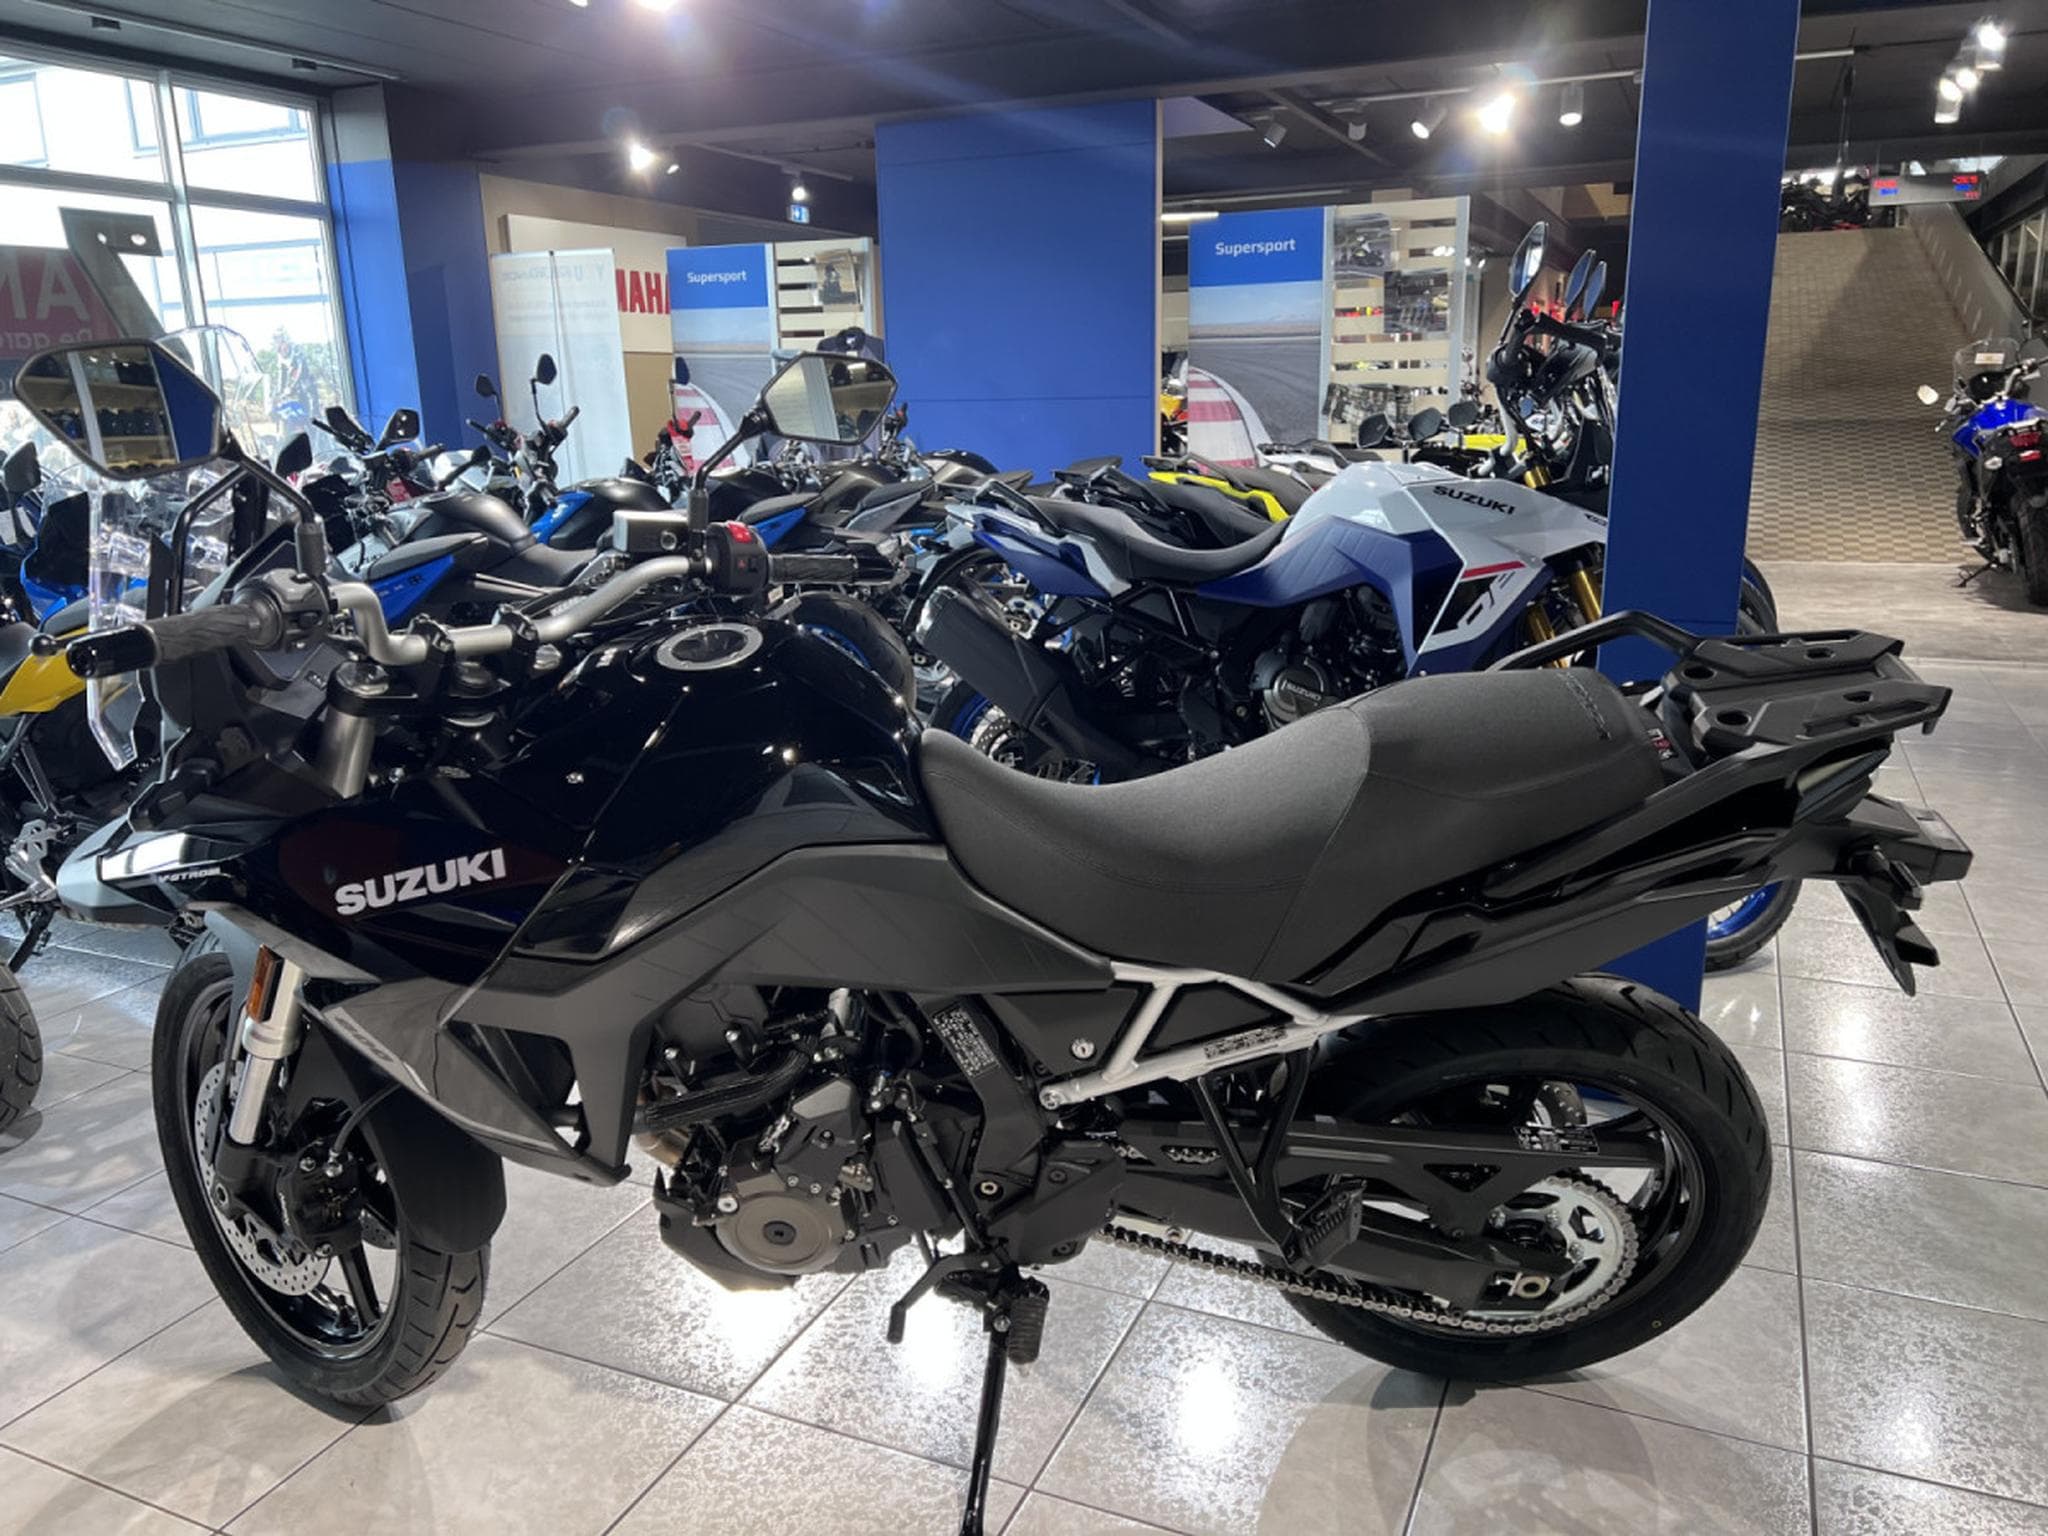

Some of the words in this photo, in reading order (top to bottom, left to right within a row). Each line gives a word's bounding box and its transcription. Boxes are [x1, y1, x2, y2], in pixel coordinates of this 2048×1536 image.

[1215, 238, 1296, 257] Supersport
[615, 269, 671, 314] AH
[687, 270, 747, 285] Supersport
[1432, 485, 1516, 515] SUZUKI
[335, 848, 506, 916] SUZUKI
